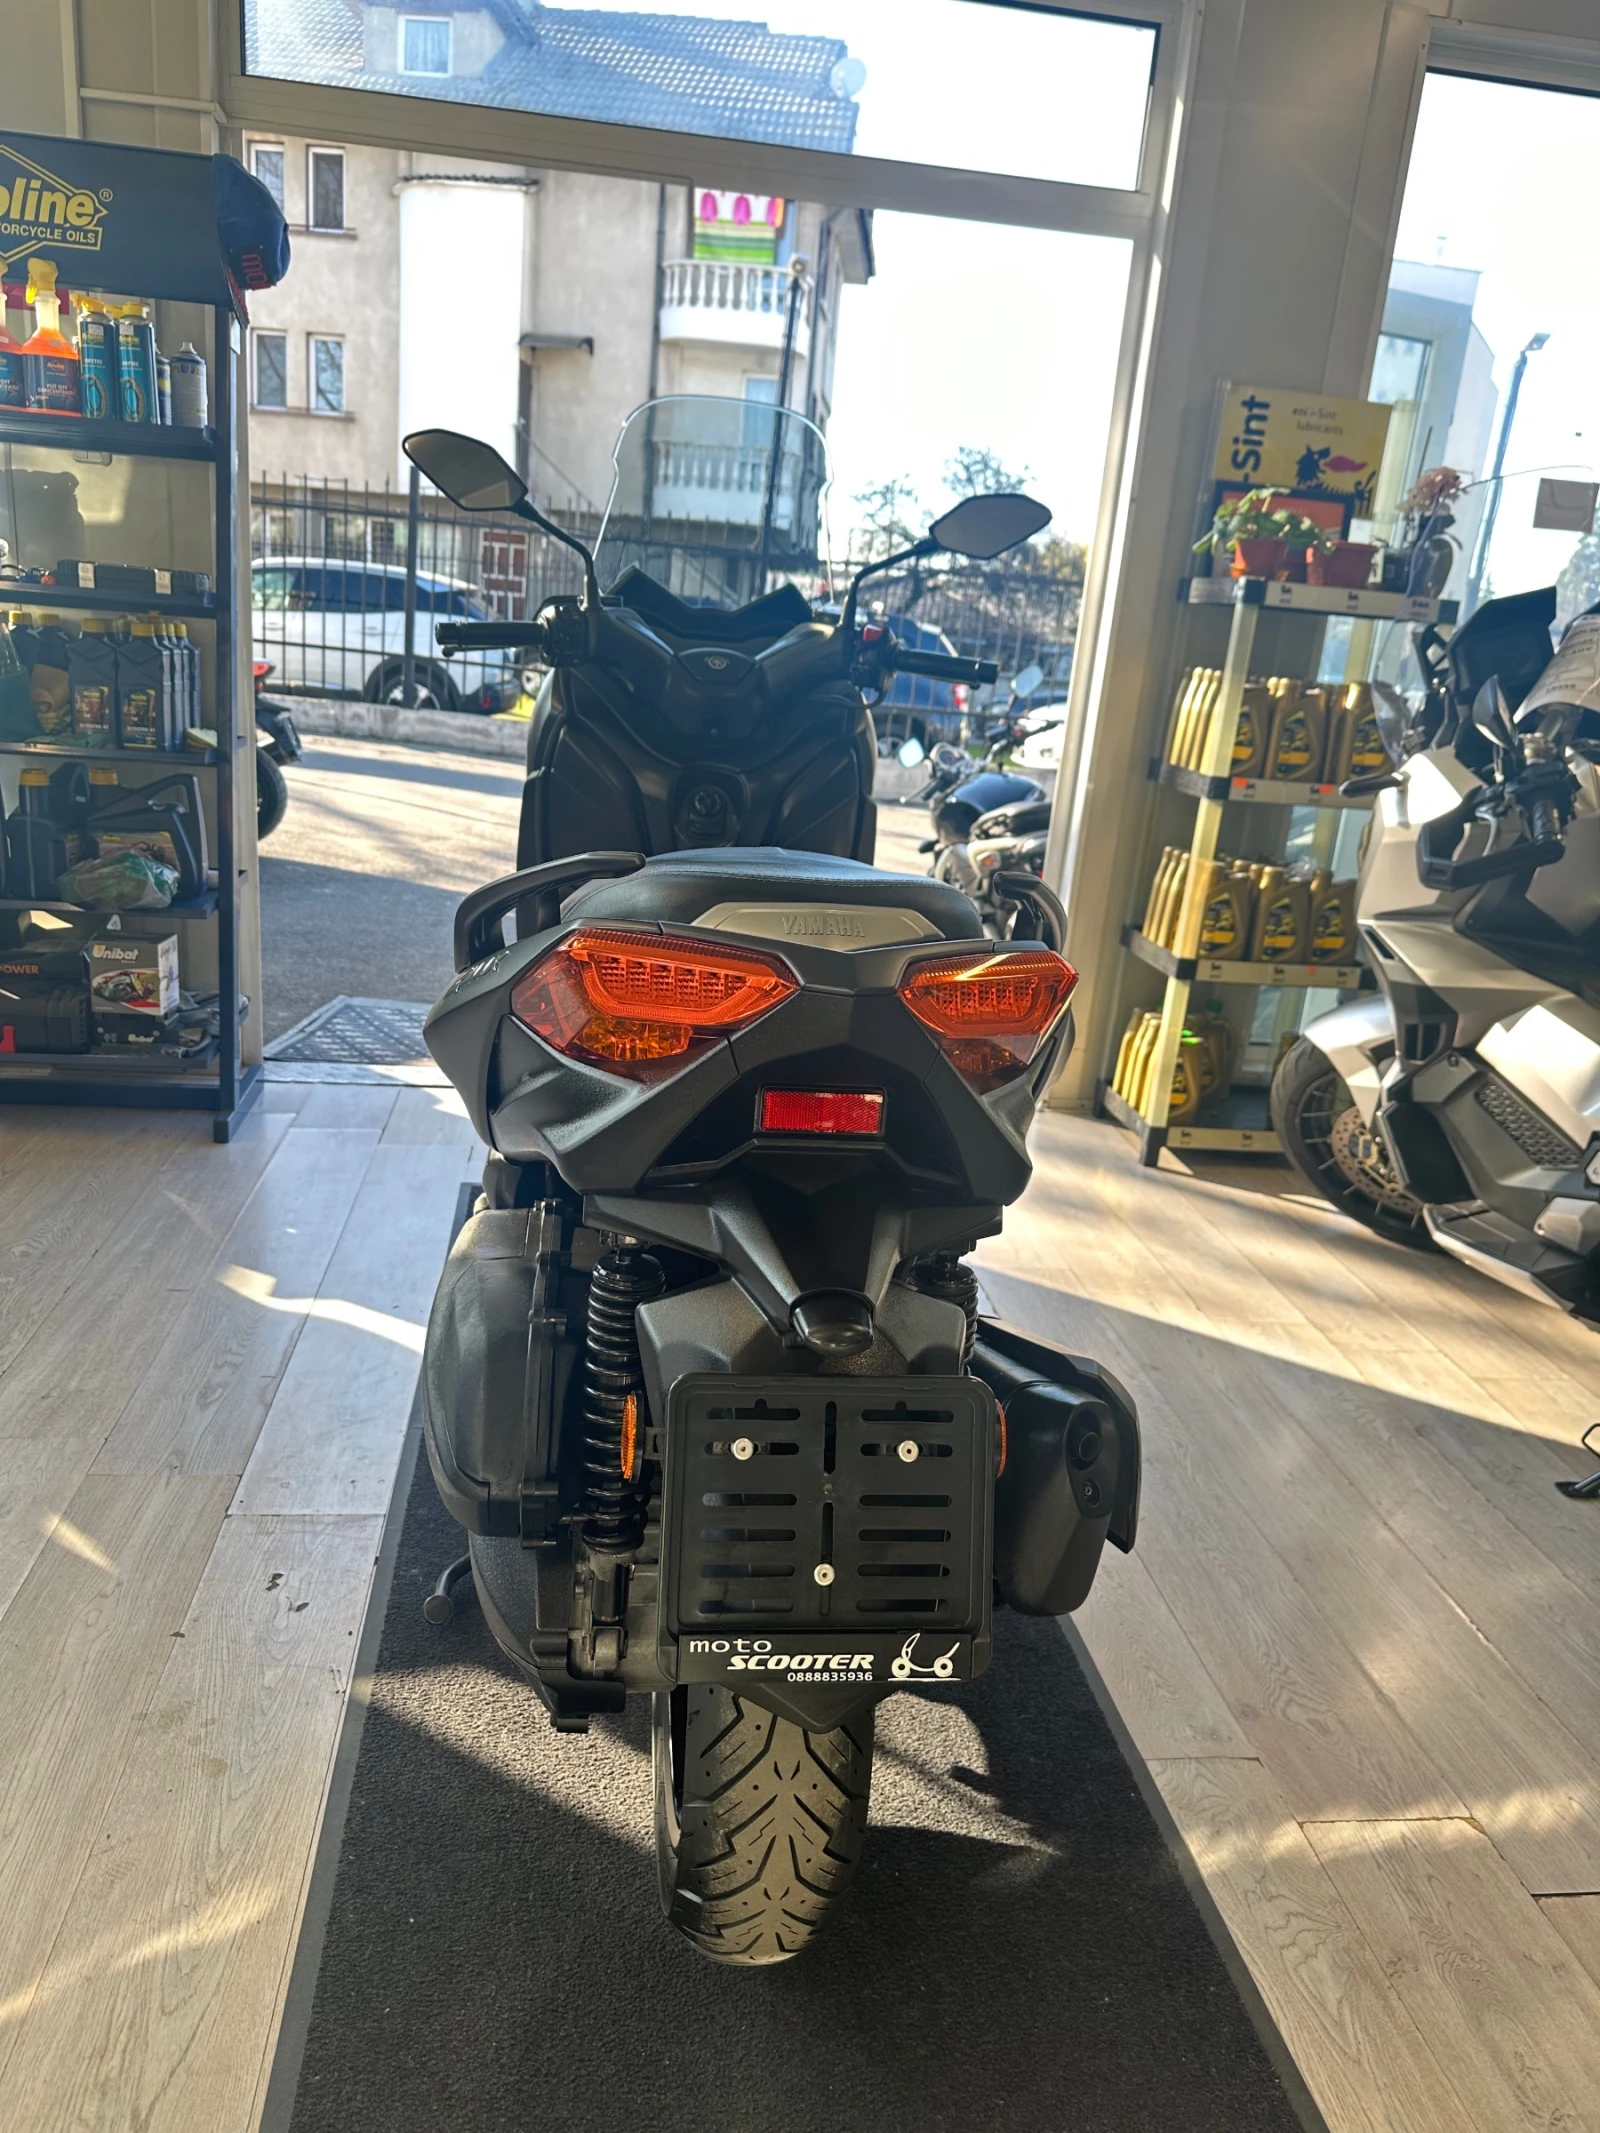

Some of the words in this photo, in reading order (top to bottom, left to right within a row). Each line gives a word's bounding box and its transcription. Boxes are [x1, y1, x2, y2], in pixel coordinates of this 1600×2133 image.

[66, 230, 96, 243] OILS
[1296, 419, 1344, 436] lubricants
[782, 915, 866, 938] YAMAHA
[92, 944, 139, 960] Unibat
[128, 1033, 155, 1043] Unibat
[689, 1638, 773, 1653] moto
[727, 1654, 875, 1670] SCOOTER
[787, 1671, 874, 1682] 0888835936
